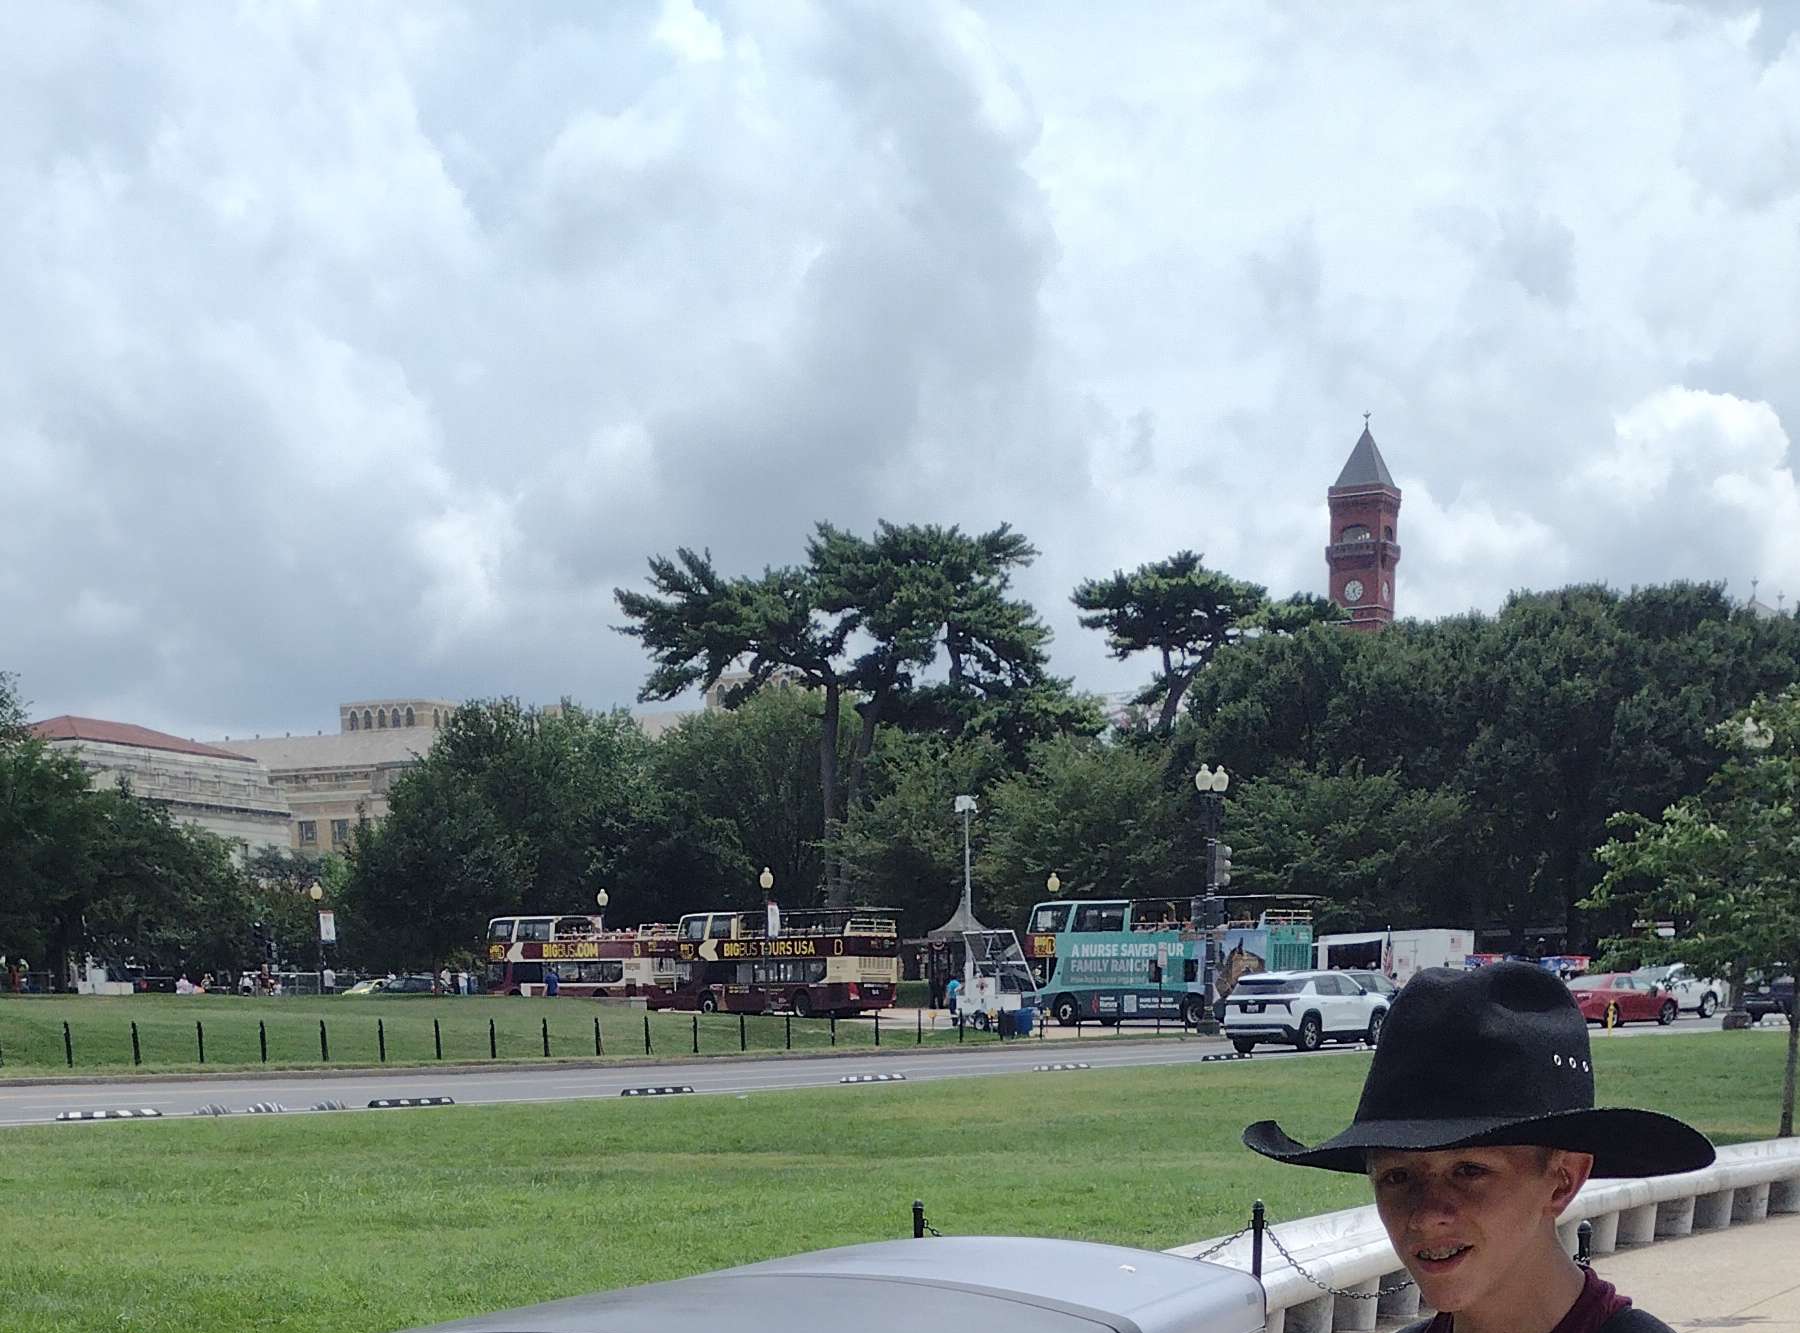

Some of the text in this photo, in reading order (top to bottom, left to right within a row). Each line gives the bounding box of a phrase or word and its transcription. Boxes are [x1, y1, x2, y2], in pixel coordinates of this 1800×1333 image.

[794, 940, 816, 955] USA
[1071, 944, 1079, 957] A
[1081, 944, 1119, 957] NURSE
[1120, 943, 1157, 957] SAVED
[1070, 959, 1149, 973] FAMILY RANCH
